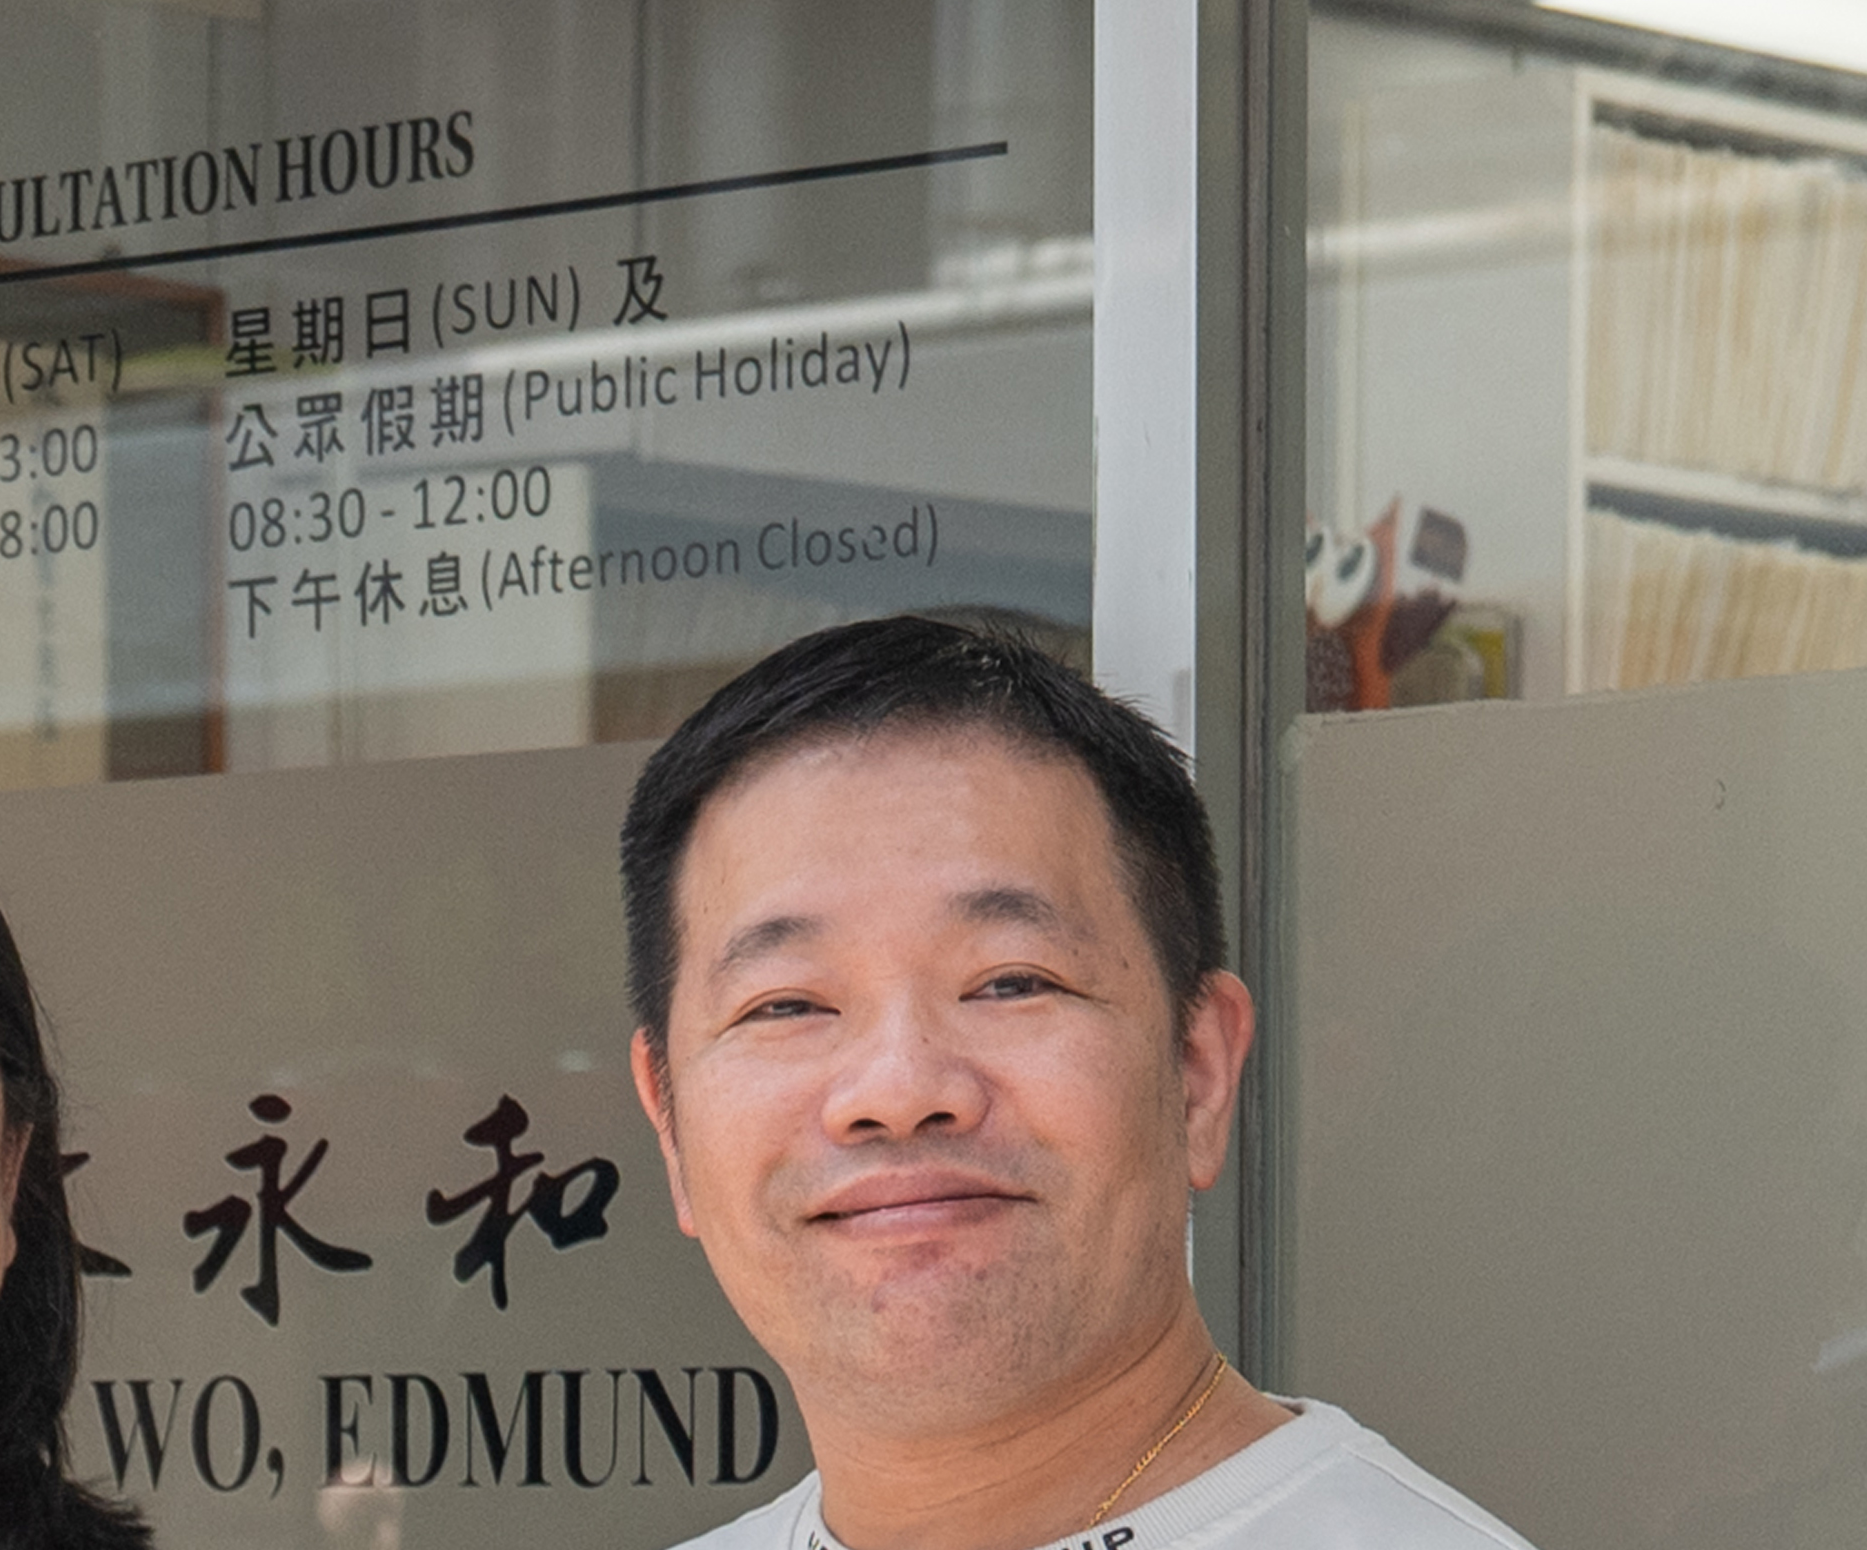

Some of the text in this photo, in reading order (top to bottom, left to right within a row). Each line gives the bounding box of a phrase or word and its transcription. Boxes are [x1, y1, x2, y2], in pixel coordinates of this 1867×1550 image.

[276, 110, 475, 204] HOURS
[3, 329, 124, 406] (SAT)
[224, 254, 669, 379] 星期日 (SUN) 及
[503, 359, 678, 435] (Public
[695, 320, 912, 401] Holiday)
[228, 487, 365, 552] 08:30
[412, 465, 551, 531] 12:00
[228, 502, 939, 639] 下午休息 (Afternoon Closed)
[92, 1366, 780, 1500] WO, EDMUND
